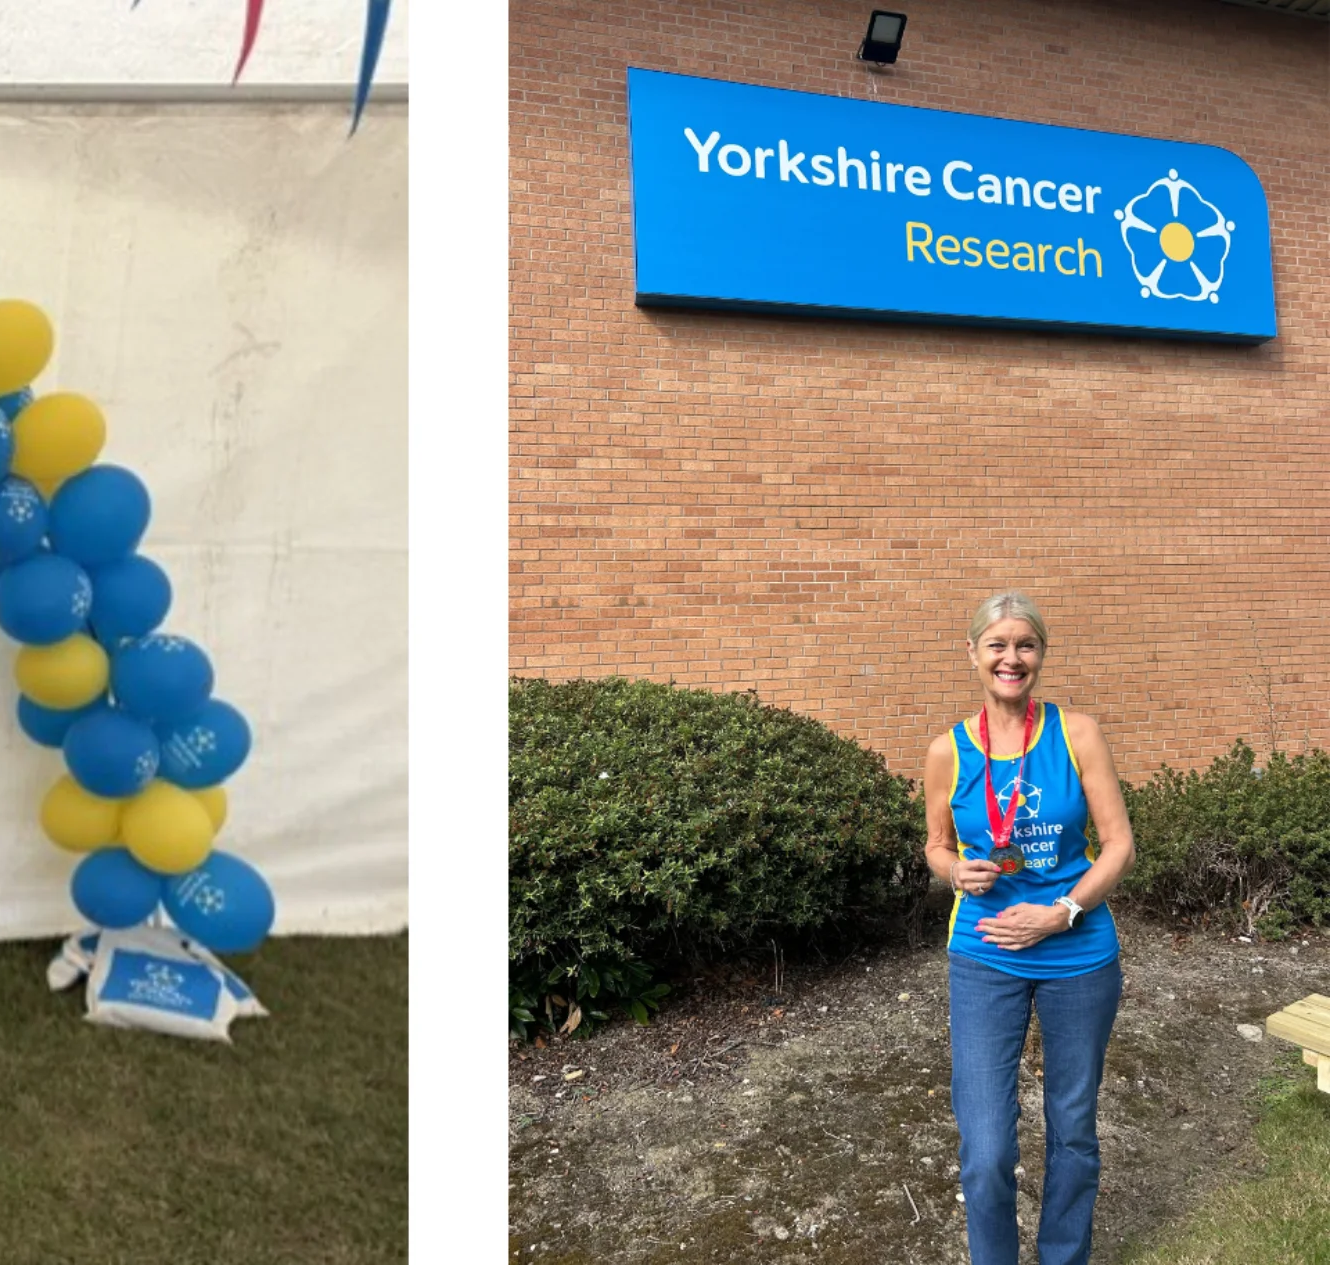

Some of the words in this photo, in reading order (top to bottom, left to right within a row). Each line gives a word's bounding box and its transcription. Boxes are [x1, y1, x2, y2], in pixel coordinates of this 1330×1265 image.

[684, 126, 931, 197] Yorkshire
[942, 160, 1103, 215] Cancer
[905, 220, 1104, 278] Research
[985, 822, 1063, 842] kshire
[1020, 840, 1056, 854] ncer
